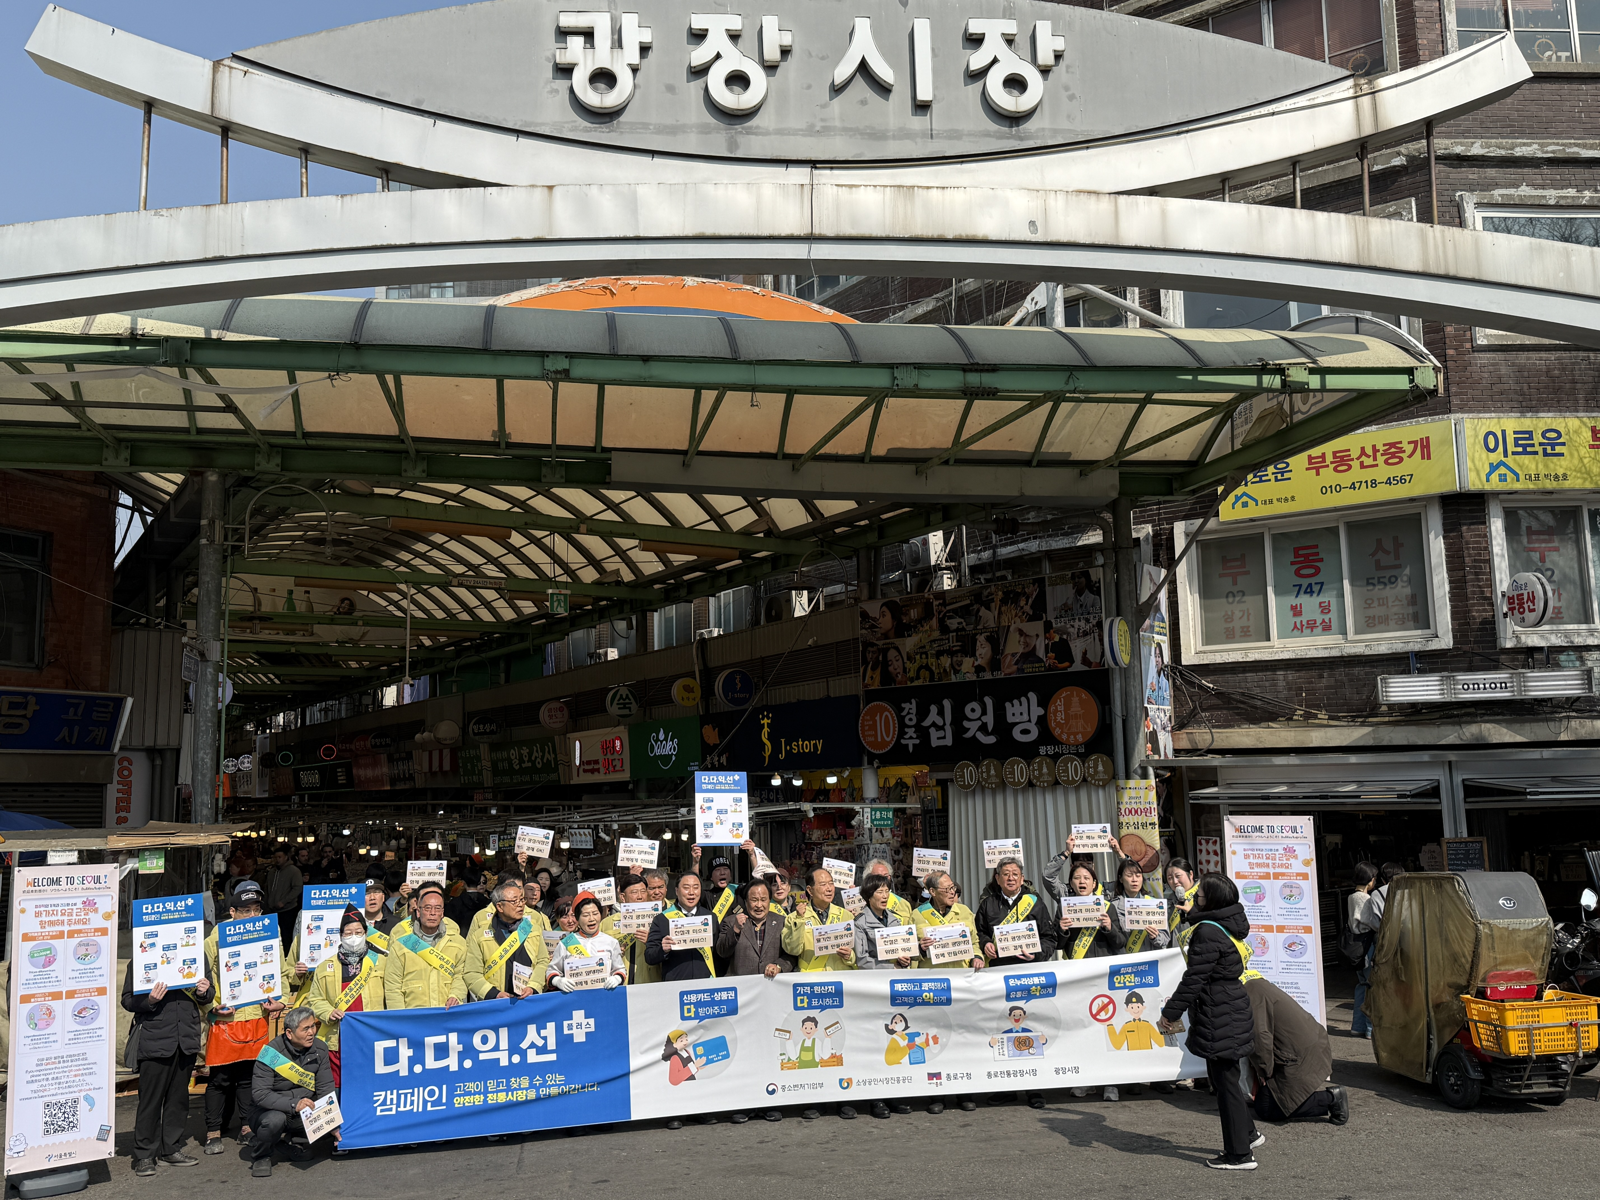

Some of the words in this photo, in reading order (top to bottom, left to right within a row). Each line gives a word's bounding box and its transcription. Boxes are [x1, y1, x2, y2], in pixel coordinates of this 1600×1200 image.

[555, 11, 1065, 117] 광장시장
[1483, 428, 1566, 458] 이로운
[1305, 436, 1432, 476] 부동산중개
[1320, 474, 1414, 495] 010-4718-4567
[1524, 473, 1541, 482] 대표
[1544, 472, 1570, 482] 박송호
[1276, 495, 1297, 504] 박송호
[1524, 526, 1560, 563] 부
[1218, 553, 1250, 586] 부
[1290, 544, 1324, 578] 동
[1368, 536, 1404, 571] 산
[1225, 590, 1246, 604] 02
[1293, 582, 1325, 598] 747
[1366, 573, 1411, 592] 5599
[1363, 593, 1418, 610] 오피스텔
[1507, 590, 1536, 616] 부동산
[1222, 608, 1251, 623] 상가
[1223, 625, 1252, 639] 점포
[1291, 617, 1332, 633] 사무실
[1462, 678, 1508, 691] onion
[61, 699, 114, 721] 고급
[616, 693, 633, 712] 쑥
[1056, 698, 1065, 723] 십원
[472, 724, 497, 733] 일호상사
[875, 711, 894, 742] 10
[900, 698, 920, 754] 경주
[921, 691, 1045, 748] 십원빵
[54, 725, 107, 745] 시계
[509, 742, 555, 770] 일호상사
[964, 766, 976, 785] 10
[1014, 763, 1026, 782] 10
[1067, 761, 1080, 781] 10
[115, 756, 133, 814] COFFEE
[1117, 806, 1156, 818] 3,000원!
[1118, 821, 1158, 830] 경주십원빵
[1234, 825, 1265, 834] WELCOME
[1266, 825, 1275, 834] TO
[26, 876, 63, 888] WELCOME
[65, 876, 75, 886] TO
[311, 889, 350, 899] 다.다.익.선
[34, 909, 58, 918] 바가지
[60, 908, 74, 917] 요금
[142, 902, 186, 914] 다.다.익.선
[226, 921, 264, 935] 다.다.익.선
[894, 982, 920, 991] 깨끗하고
[921, 982, 947, 991] 쾌적해서
[1008, 976, 1047, 985] 온누리상품권
[1113, 975, 1141, 987] 안전한
[1141, 975, 1154, 984] 시장
[797, 995, 808, 1008] 다
[811, 997, 840, 1006] 표시하고
[683, 1005, 695, 1018] 다
[698, 1005, 727, 1015] 받아주고
[373, 1021, 557, 1077] 다.다.익.선
[567, 1021, 592, 1031] 플러스
[945, 1072, 972, 1081] 종로구청
[986, 1068, 1038, 1079] 종로전통광장시장
[1053, 1065, 1080, 1075] 광장시장
[454, 1082, 484, 1095] 고객이
[487, 1078, 507, 1090] 믿고
[509, 1077, 530, 1089] 찾을
[532, 1075, 544, 1087] 수
[546, 1073, 566, 1085] 있는
[780, 1081, 824, 1093] 중소벤처기업부
[855, 1075, 913, 1087] 소상공인시장진흥공단
[373, 1084, 447, 1116] 캠페인
[454, 1094, 484, 1108] 안전한
[487, 1088, 537, 1105] 전통시장을
[539, 1082, 601, 1100] 만들어갑니다.
[54, 1151, 77, 1160] 서울특별시
